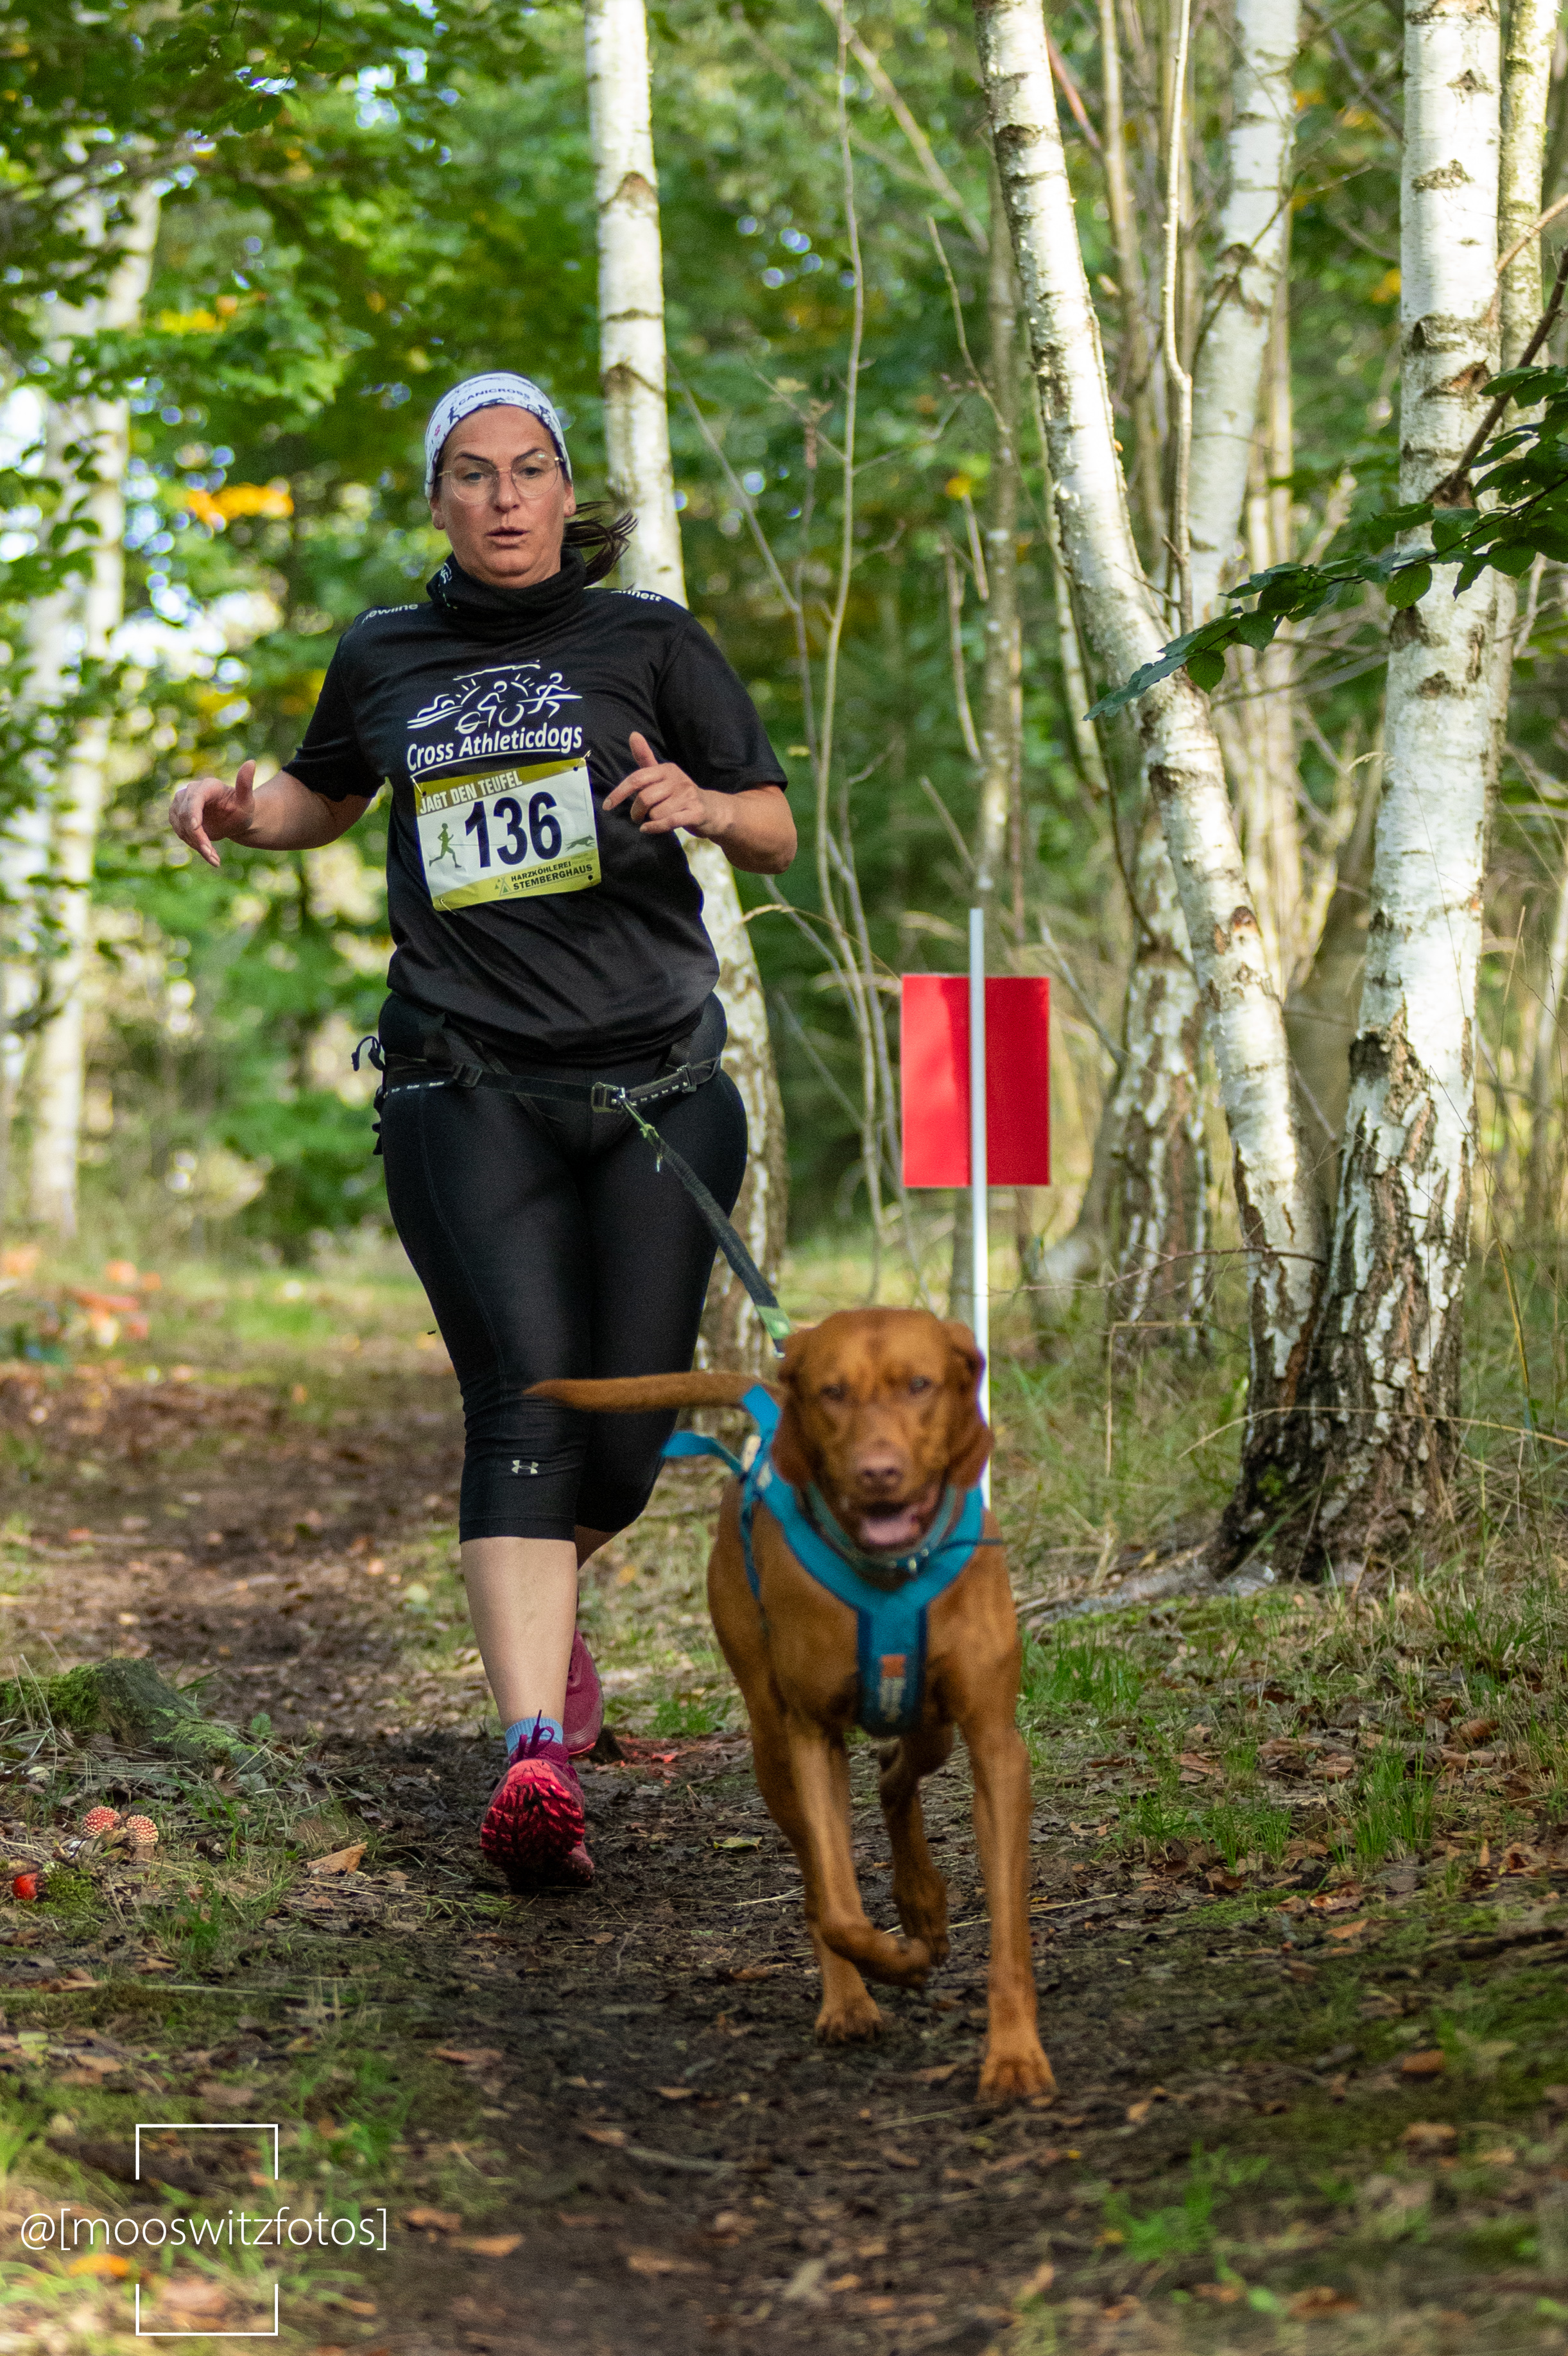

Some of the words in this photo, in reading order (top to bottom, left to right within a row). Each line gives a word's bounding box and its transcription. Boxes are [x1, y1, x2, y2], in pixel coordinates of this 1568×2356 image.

[407, 743, 454, 771] Cross
[459, 722, 582, 754] Athleticdogs
[419, 791, 447, 815] JAGT
[451, 782, 477, 805] DEN
[478, 770, 523, 796] TEUFEL
[464, 791, 562, 868] 136
[511, 861, 571, 882] HARZKÖHLEREI
[513, 864, 593, 891] STEMBERGHAUS
